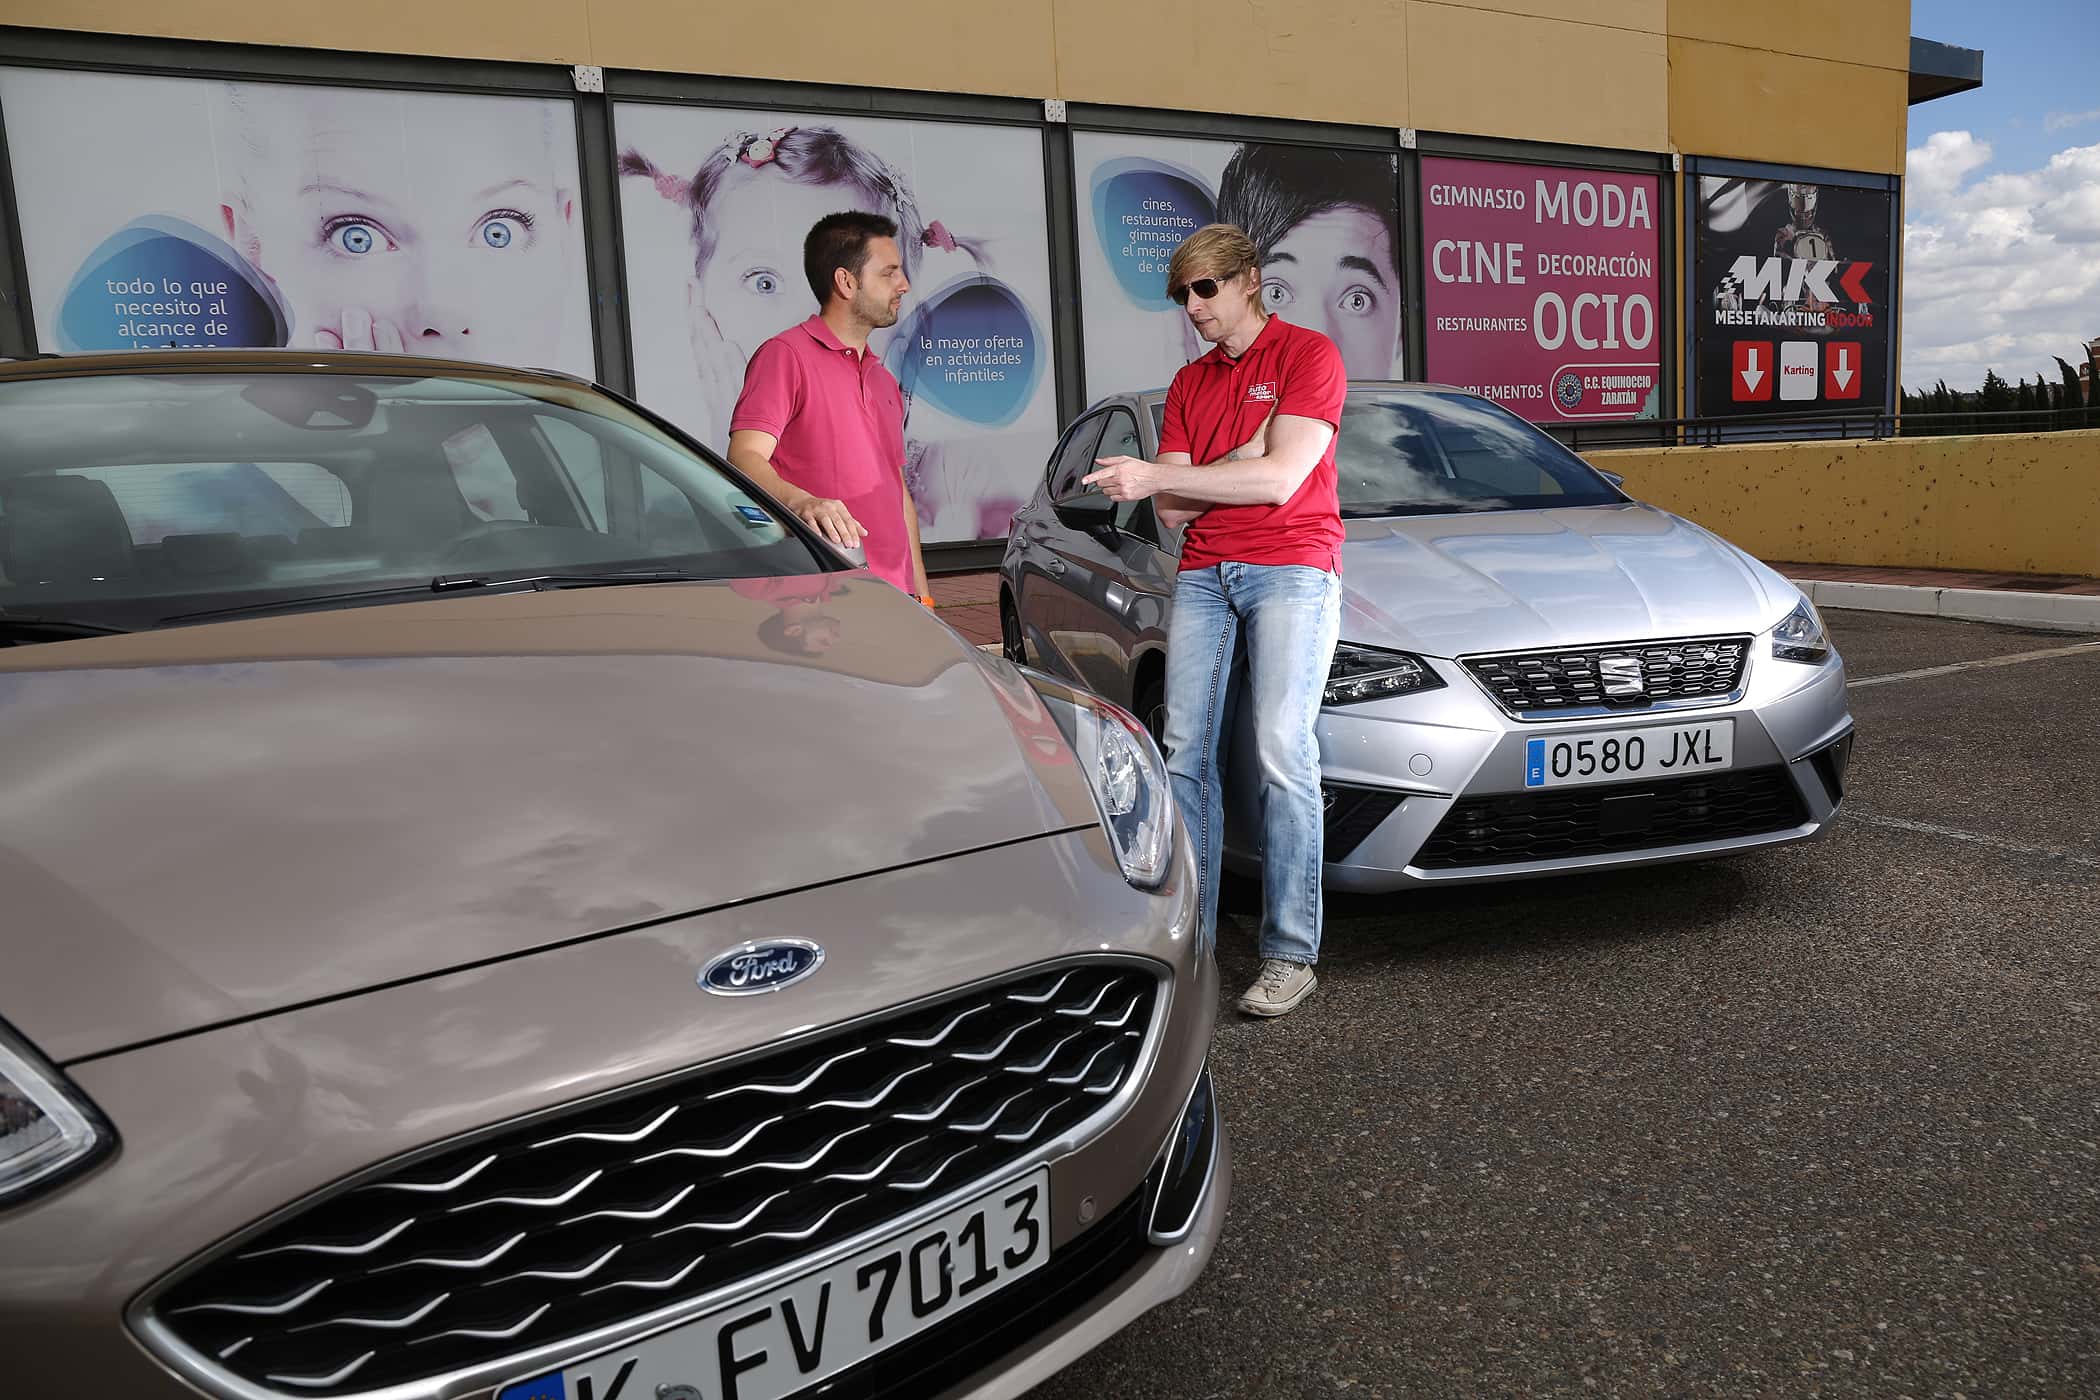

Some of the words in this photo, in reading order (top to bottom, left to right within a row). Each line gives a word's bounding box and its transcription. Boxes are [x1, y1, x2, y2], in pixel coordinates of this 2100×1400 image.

[1142, 197, 1176, 212] cines,
[1430, 184, 1526, 210] GIMNASIO
[1535, 179, 1652, 230] MODA
[1122, 214, 1197, 229] restaurantes,
[1122, 244, 1134, 257] el
[1137, 245, 1171, 261] mejor
[1138, 260, 1153, 273] de
[1156, 263, 1171, 273] oc
[1432, 239, 1526, 285] CINE
[1537, 251, 1652, 279] DECORACIÓN
[105, 278, 155, 294] todo
[162, 278, 182, 294] lo
[190, 281, 228, 299] que
[114, 299, 201, 315] necesito
[209, 299, 228, 315] al
[118, 319, 196, 336] alcance
[203, 319, 229, 336] de
[1436, 316, 1528, 332] RESTAURANTES
[1532, 291, 1654, 351] OCIO
[920, 335, 933, 350] la
[938, 338, 980, 352] mayor
[984, 335, 1024, 351] oferta
[926, 355, 943, 366] en
[947, 351, 1021, 366] actividades
[945, 368, 1005, 384] infantiles
[1784, 365, 1815, 377] Karting
[1584, 376, 1601, 389] C.C.
[1601, 375, 1652, 389] EQUINOCCIO
[1463, 384, 1544, 400] PLEMENTOS
[1601, 389, 1637, 405] ZARATÁN
[1551, 736, 1645, 778] 0580
[1659, 729, 1723, 768] JXL
[1531, 768, 1541, 778] E
[729, 949, 798, 986] Ford
[716, 1281, 832, 1400] FV
[856, 1184, 1040, 1344] 7013
